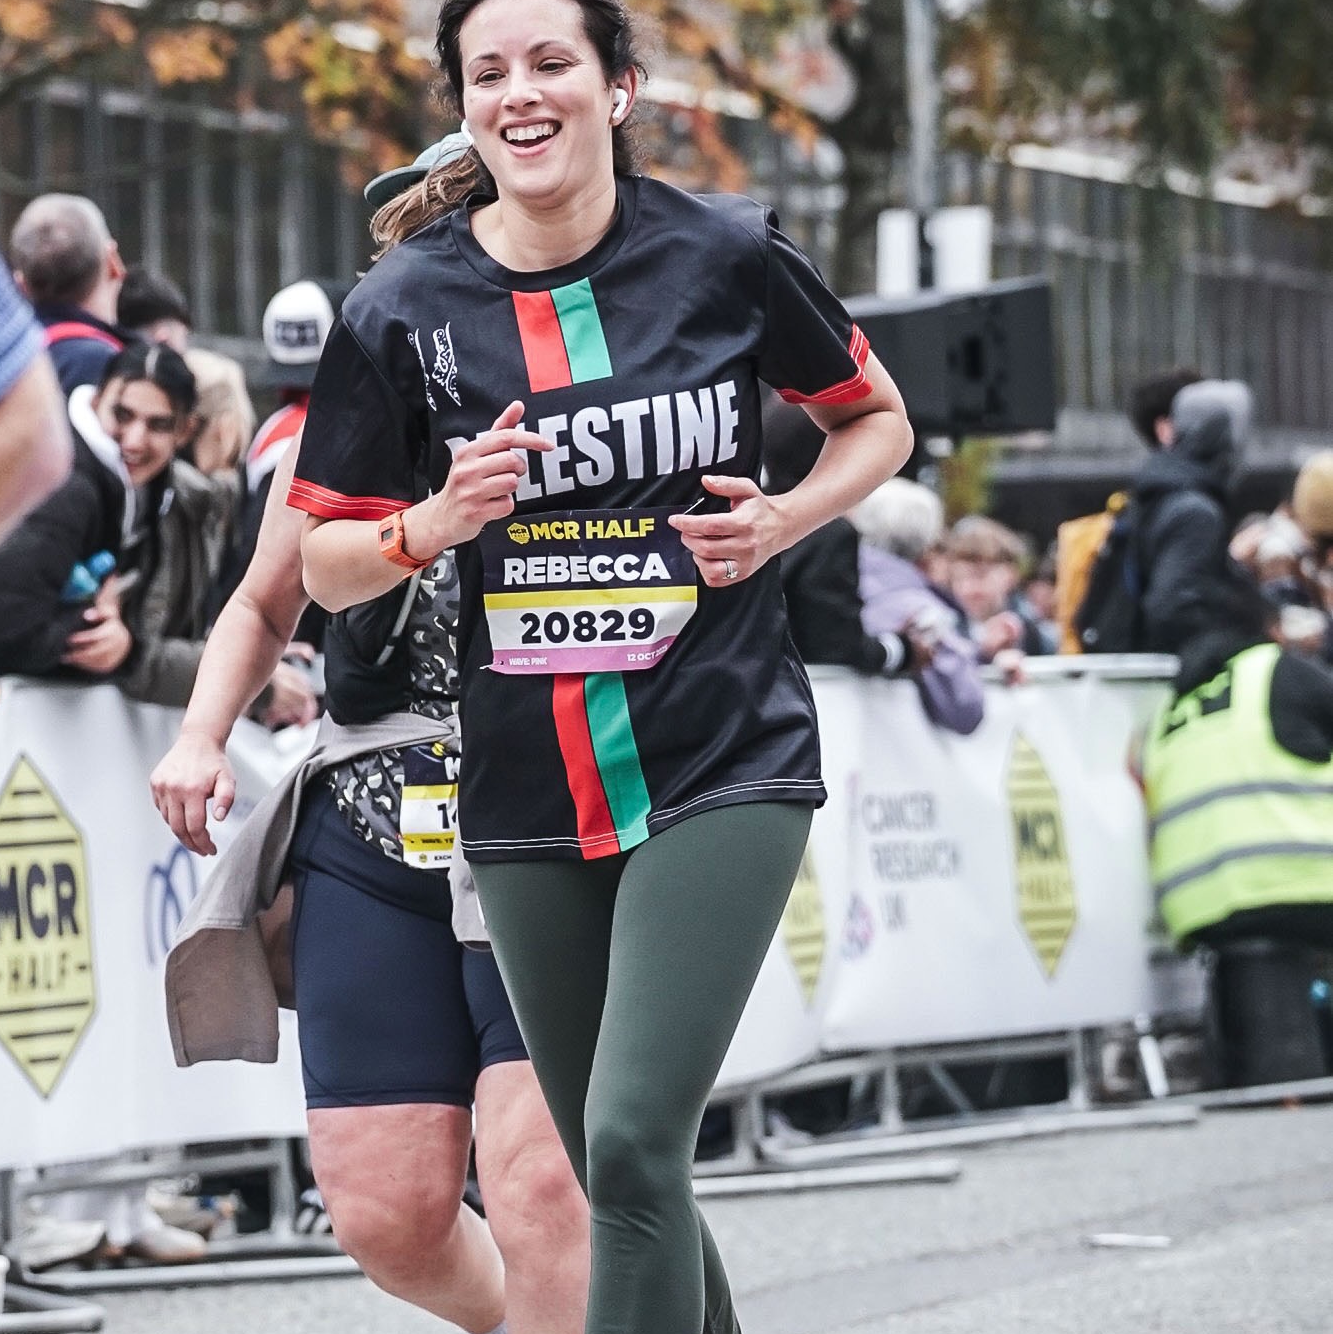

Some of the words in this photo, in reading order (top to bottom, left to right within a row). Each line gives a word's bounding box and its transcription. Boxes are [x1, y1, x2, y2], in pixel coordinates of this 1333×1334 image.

[445, 380, 739, 501] LESTINE
[529, 522, 580, 540] MCR
[585, 518, 655, 539] HALF
[504, 553, 672, 585] REBECCA
[520, 608, 655, 644] 20829
[627, 653, 636, 662] 12
[637, 651, 656, 661] OCT
[437, 803, 457, 829] 1
